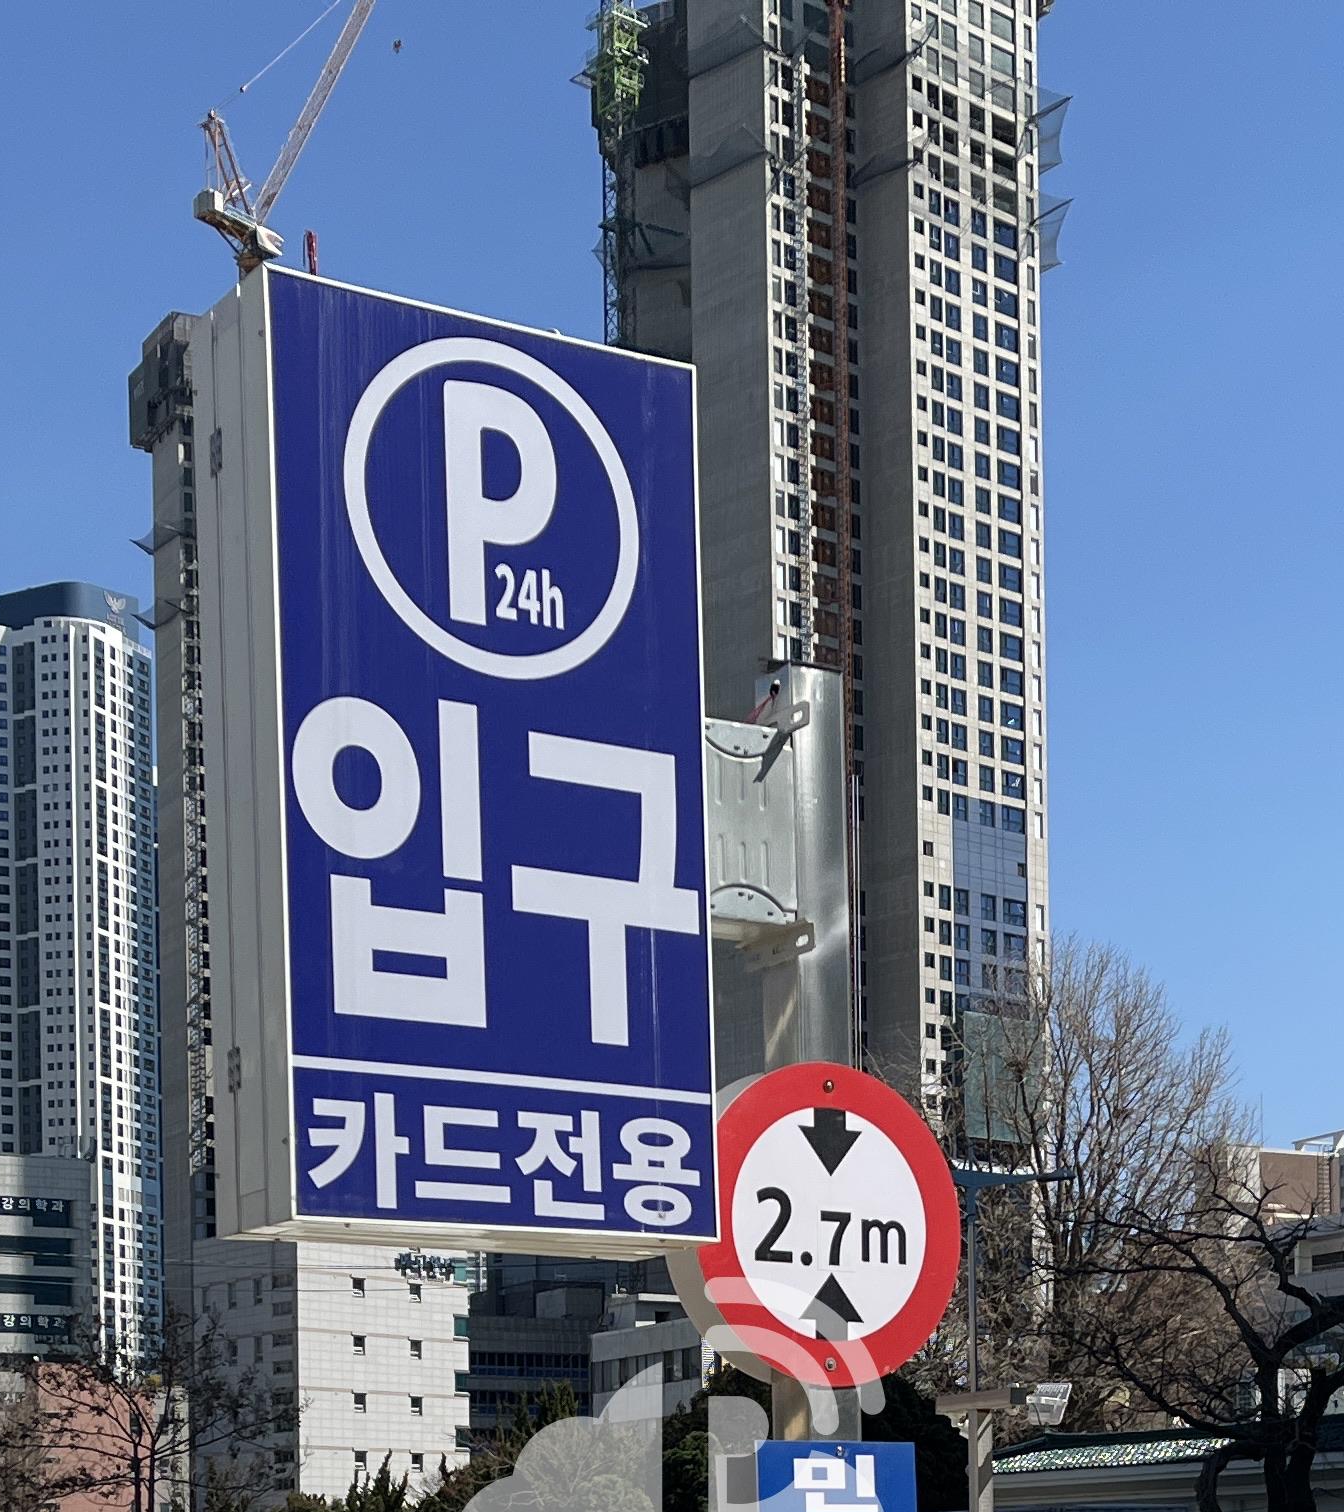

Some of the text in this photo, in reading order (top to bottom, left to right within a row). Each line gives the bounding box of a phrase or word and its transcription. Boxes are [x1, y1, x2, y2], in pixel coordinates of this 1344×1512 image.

[443, 379, 557, 627] P
[494, 562, 565, 631] 24h
[292, 695, 701, 1048] 입구
[307, 1092, 701, 1227] 카드전용
[754, 1186, 907, 1266] 2.7m
